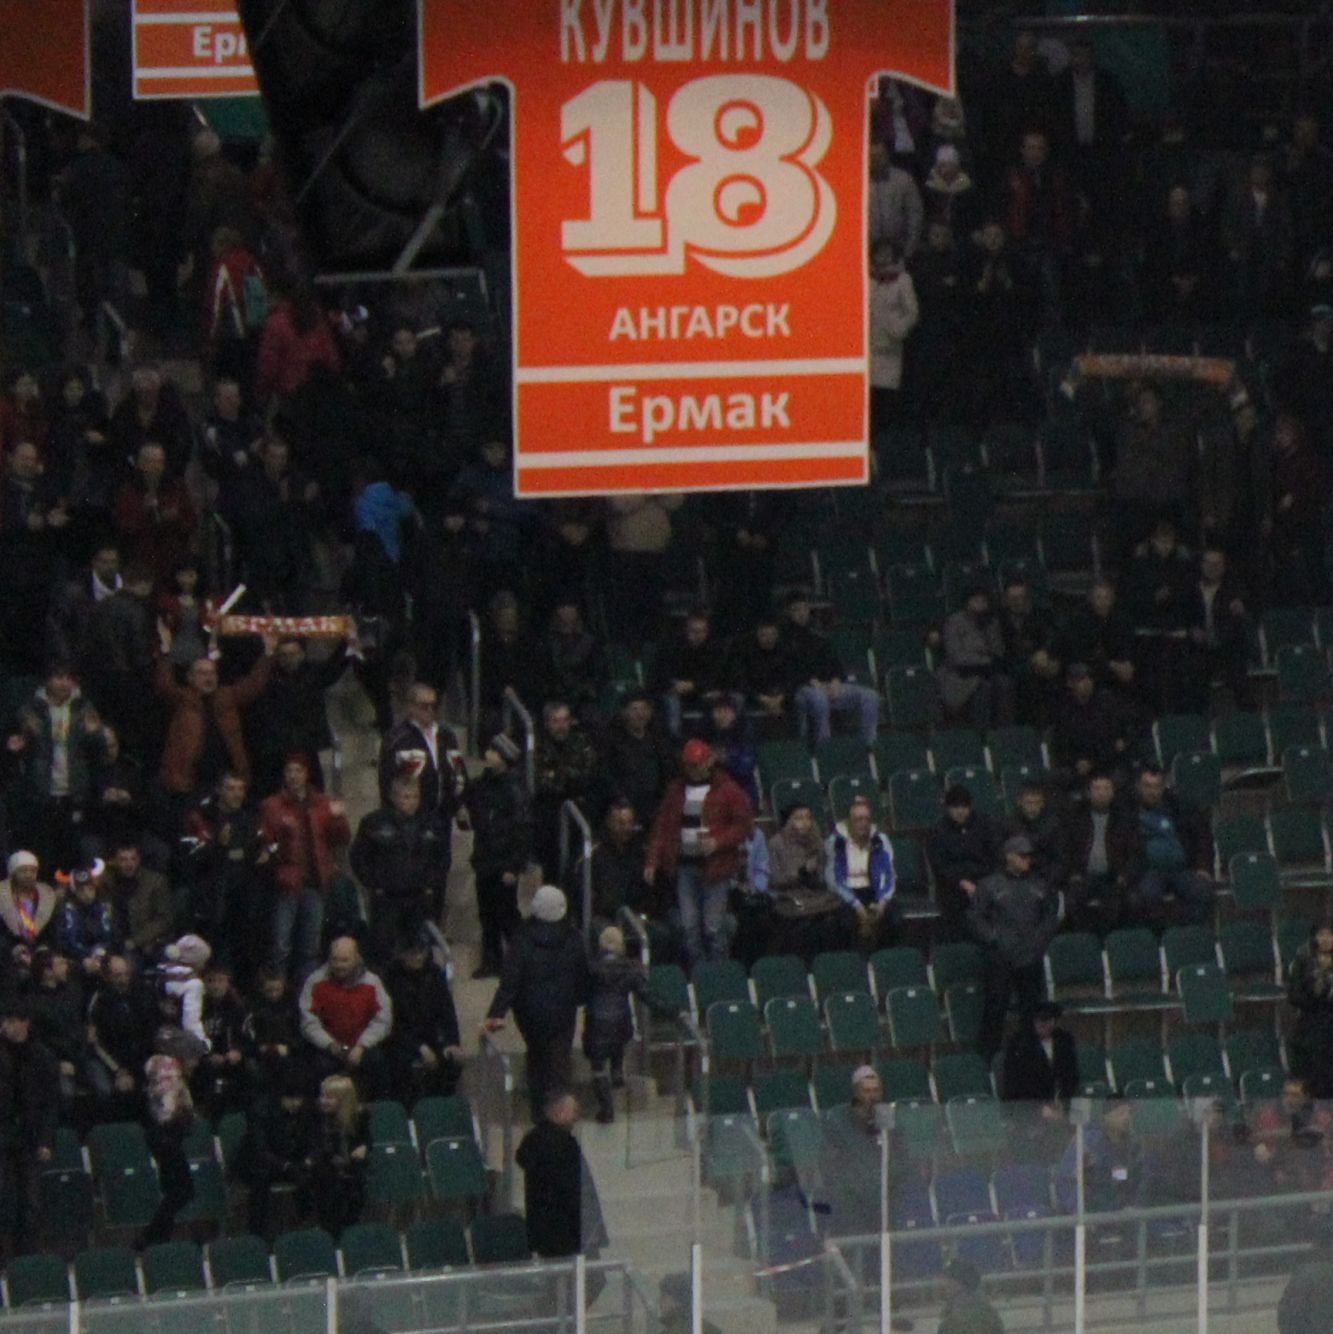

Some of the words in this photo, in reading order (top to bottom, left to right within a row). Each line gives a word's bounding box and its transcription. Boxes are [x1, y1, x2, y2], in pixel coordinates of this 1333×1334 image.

[560, 0, 830, 64] КУВШИНОВ
[560, 74, 837, 278] 18
[609, 303, 792, 342] АНГАРСК
[609, 386, 792, 440] Ермак
